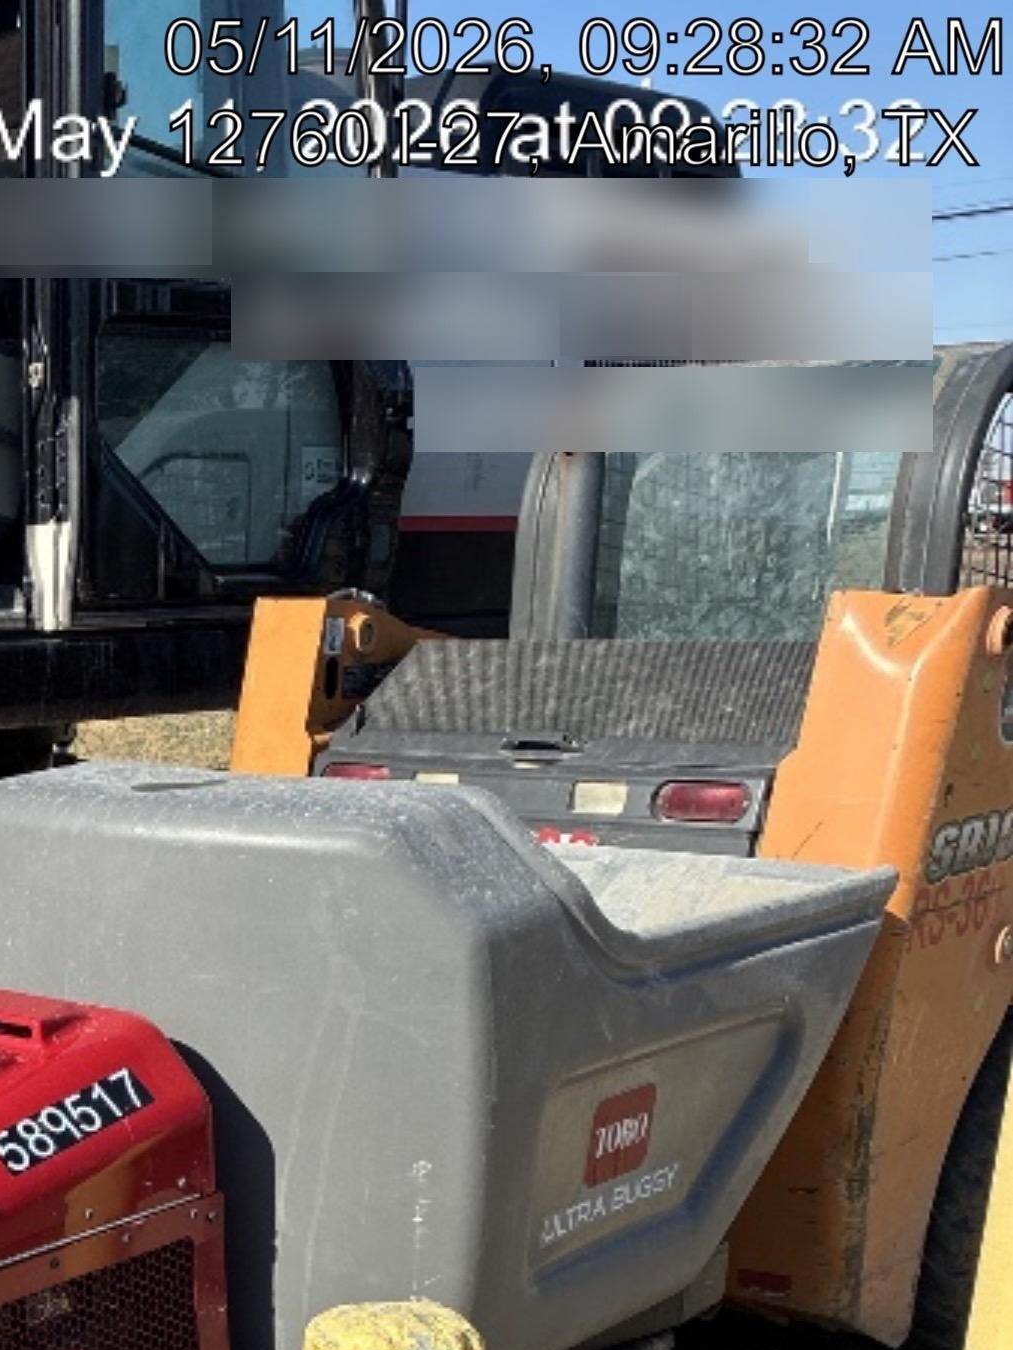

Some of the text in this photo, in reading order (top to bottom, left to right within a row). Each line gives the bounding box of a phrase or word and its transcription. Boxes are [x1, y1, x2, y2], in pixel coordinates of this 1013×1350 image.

[594, 1111, 649, 1159] TORO
[541, 1162, 681, 1244] ULTRA BUGGY
